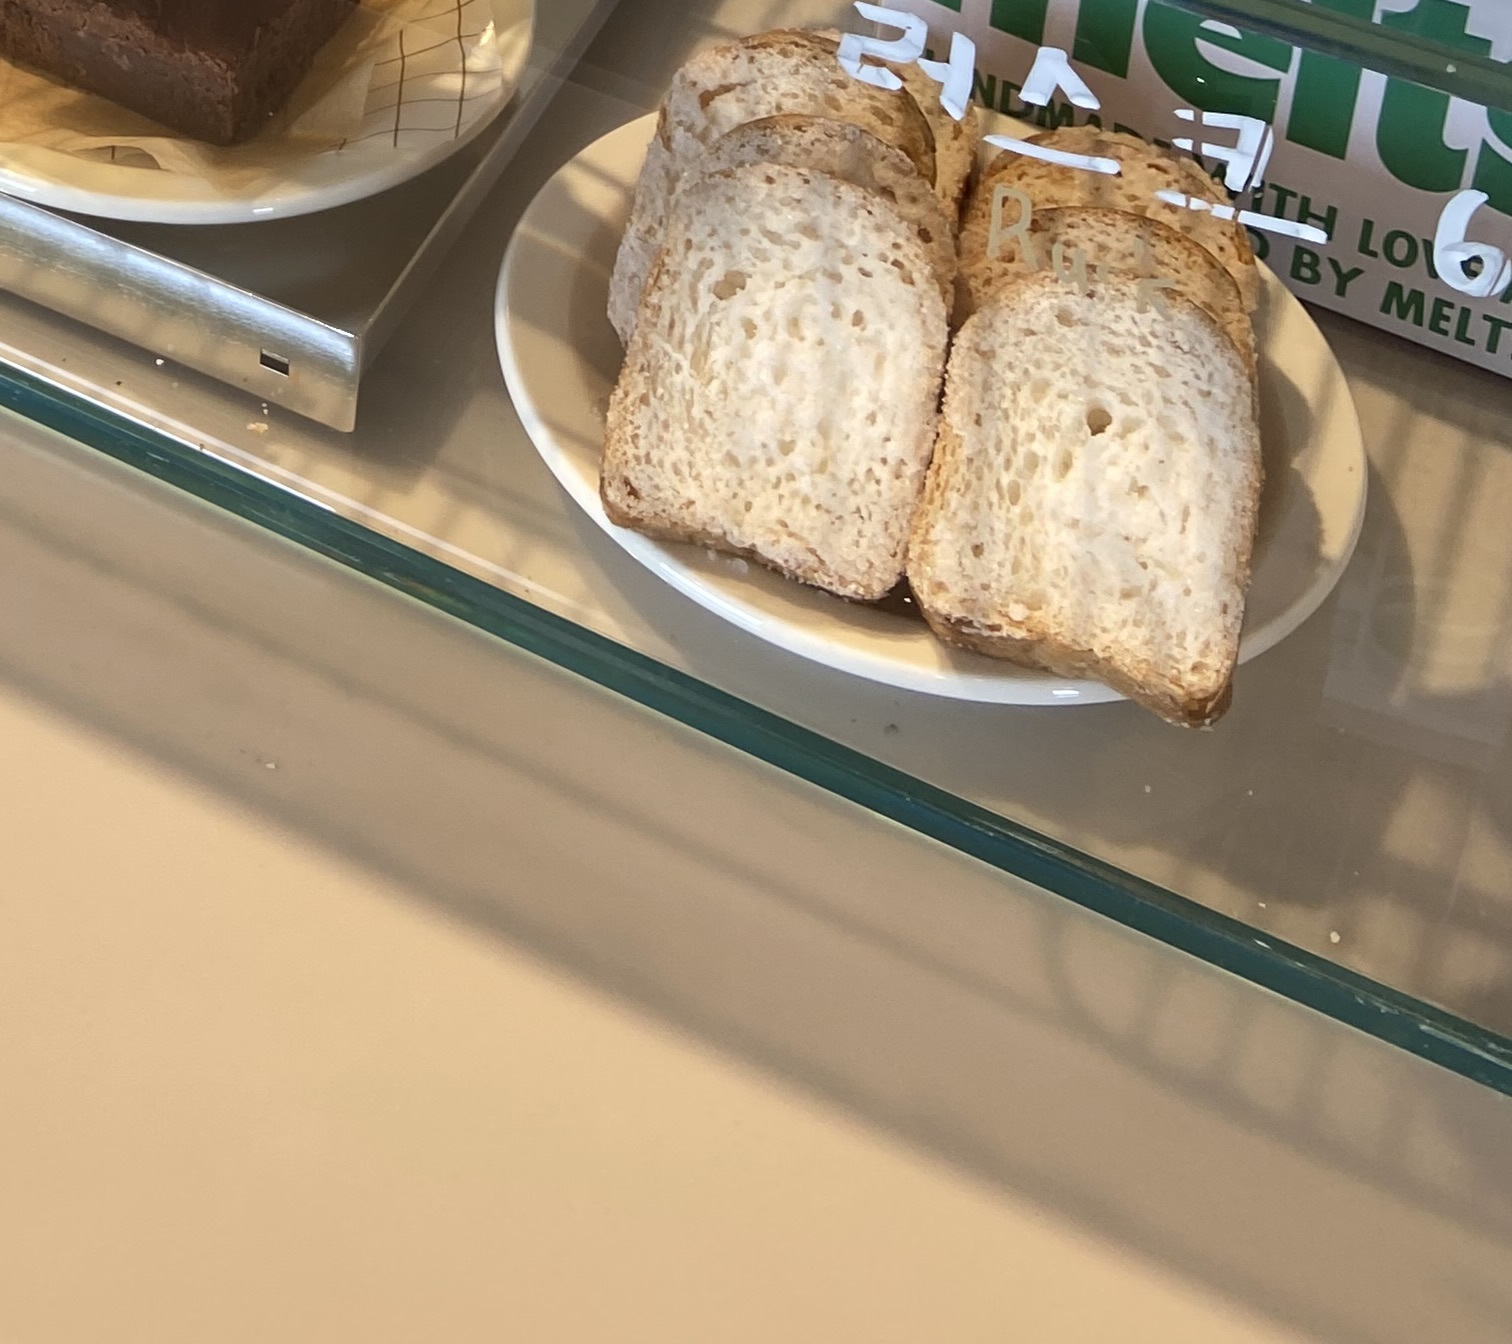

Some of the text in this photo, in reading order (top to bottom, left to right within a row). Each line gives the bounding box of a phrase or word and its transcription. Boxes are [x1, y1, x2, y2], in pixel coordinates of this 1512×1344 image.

[837, 0, 1328, 244] 러스크
[1289, 244, 1366, 299] BY
[1379, 280, 1512, 360] MELT
